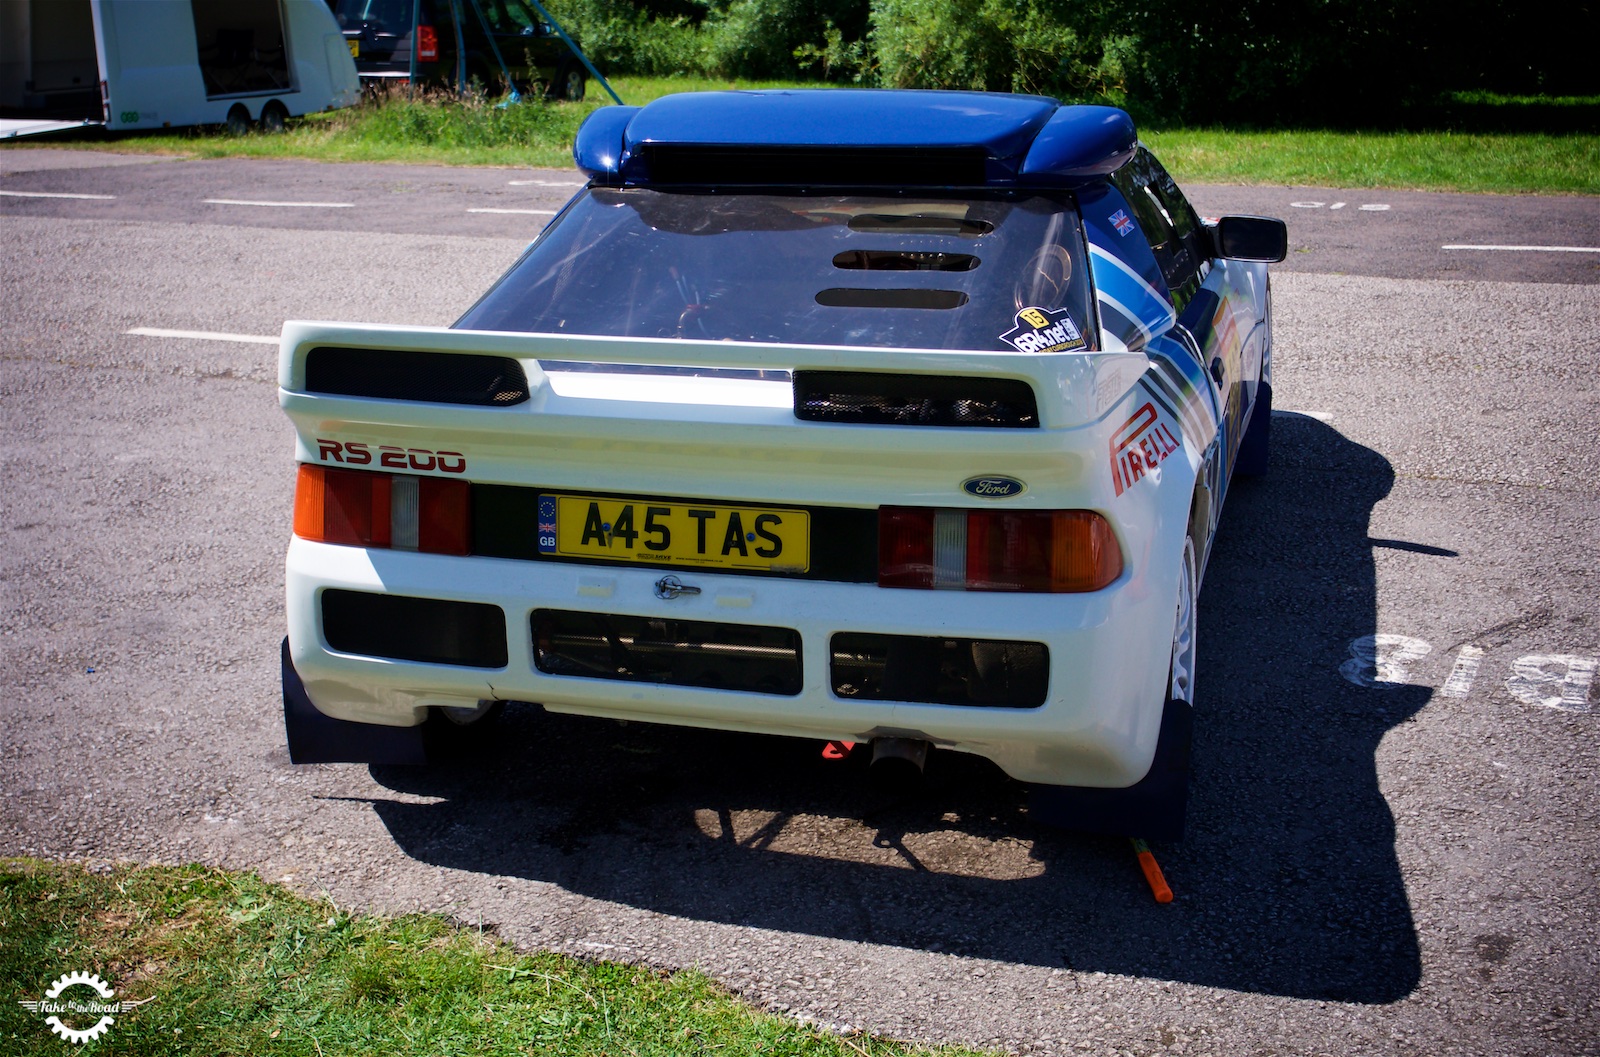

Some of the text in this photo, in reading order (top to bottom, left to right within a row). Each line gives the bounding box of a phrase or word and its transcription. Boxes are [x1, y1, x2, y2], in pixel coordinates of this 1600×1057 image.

[1024, 311, 1045, 326] 15
[1014, 322, 1071, 353] 6R4.net
[316, 438, 466, 473] RS 200
[1109, 402, 1180, 497] PIRELLI
[975, 479, 1010, 494] Ford
[539, 536, 556, 547] GB
[581, 502, 783, 558] A45 TAS
